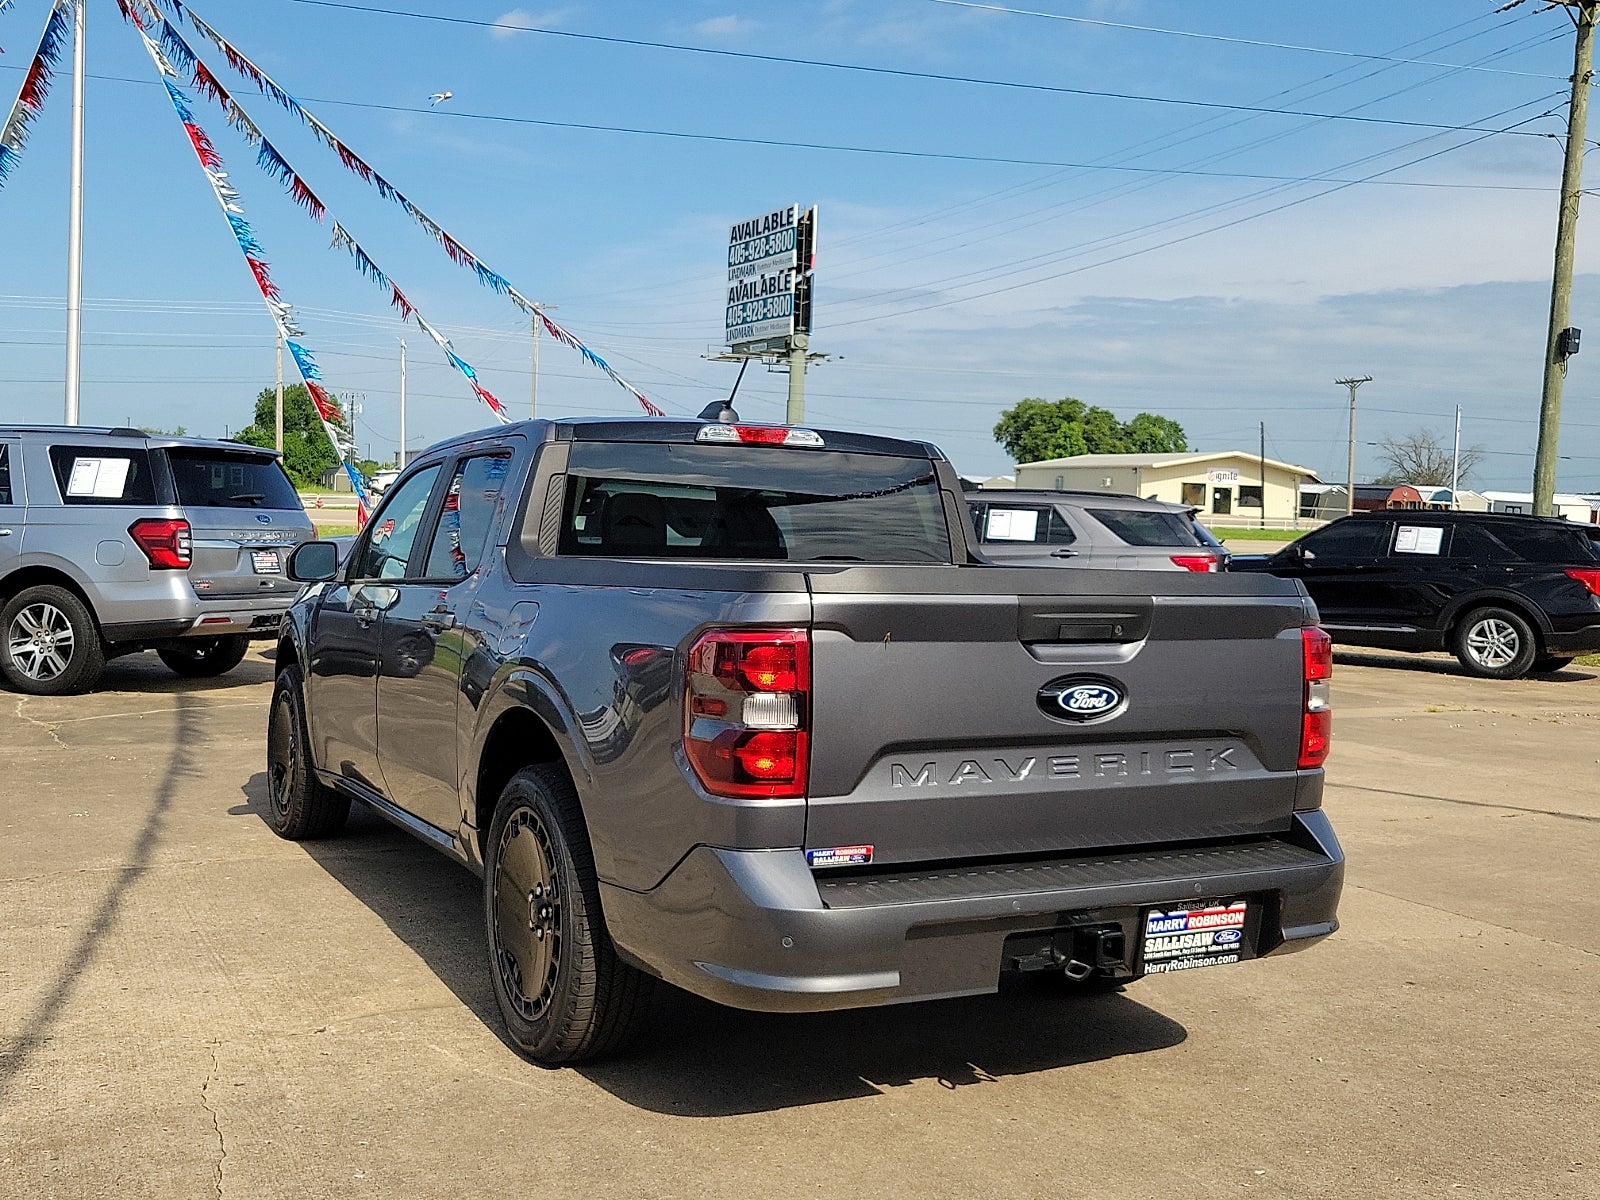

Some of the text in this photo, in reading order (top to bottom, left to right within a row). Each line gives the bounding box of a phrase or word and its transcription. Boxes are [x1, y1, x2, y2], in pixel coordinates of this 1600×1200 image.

[730, 207, 794, 244] AVAILABLE
[729, 229, 794, 265] 405-928-5800
[728, 264, 757, 281] LINDMARK
[728, 274, 791, 305] AVAILABLE
[727, 296, 791, 326] 405-928-5800
[726, 325, 755, 342] LINDMARK
[1215, 472, 1238, 482] ignite
[1070, 689, 1107, 709] Ford
[891, 748, 1237, 787] MAVERICK
[1148, 911, 1244, 933] HARRY ROBINSON
[1145, 932, 1215, 953] SALLISAW
[1144, 954, 1239, 975] HarryRobinson.com
